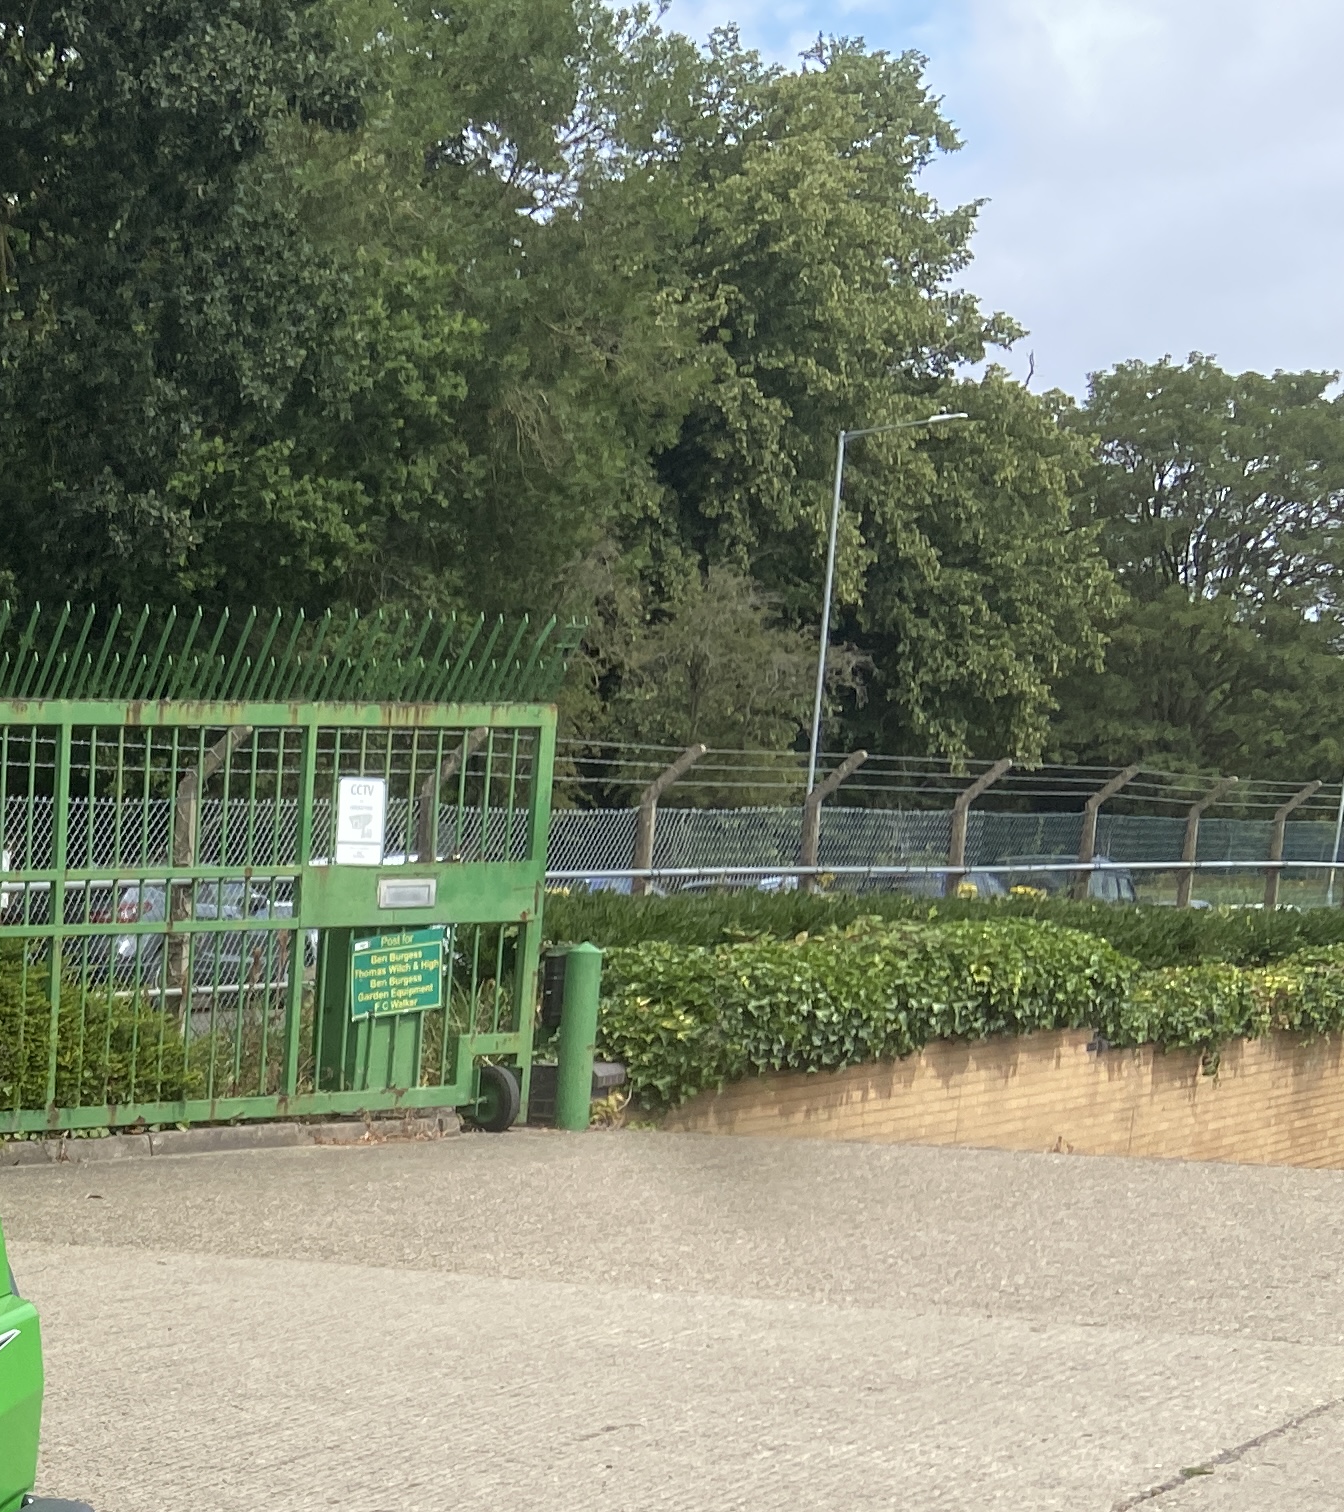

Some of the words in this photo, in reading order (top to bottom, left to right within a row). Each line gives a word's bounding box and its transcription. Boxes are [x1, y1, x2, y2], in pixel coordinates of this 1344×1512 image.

[350, 784, 375, 796] CCTV
[381, 934, 401, 948] Post
[402, 932, 414, 945] for
[370, 955, 388, 965] Ben
[389, 950, 423, 962] Burgess
[355, 967, 387, 980] Thomas
[421, 959, 439, 972] High
[370, 979, 388, 989] Ben
[389, 974, 423, 986] Burgess
[358, 990, 390, 1003] Garden
[390, 983, 434, 998] Equipment
[390, 998, 419, 1010] Walker
